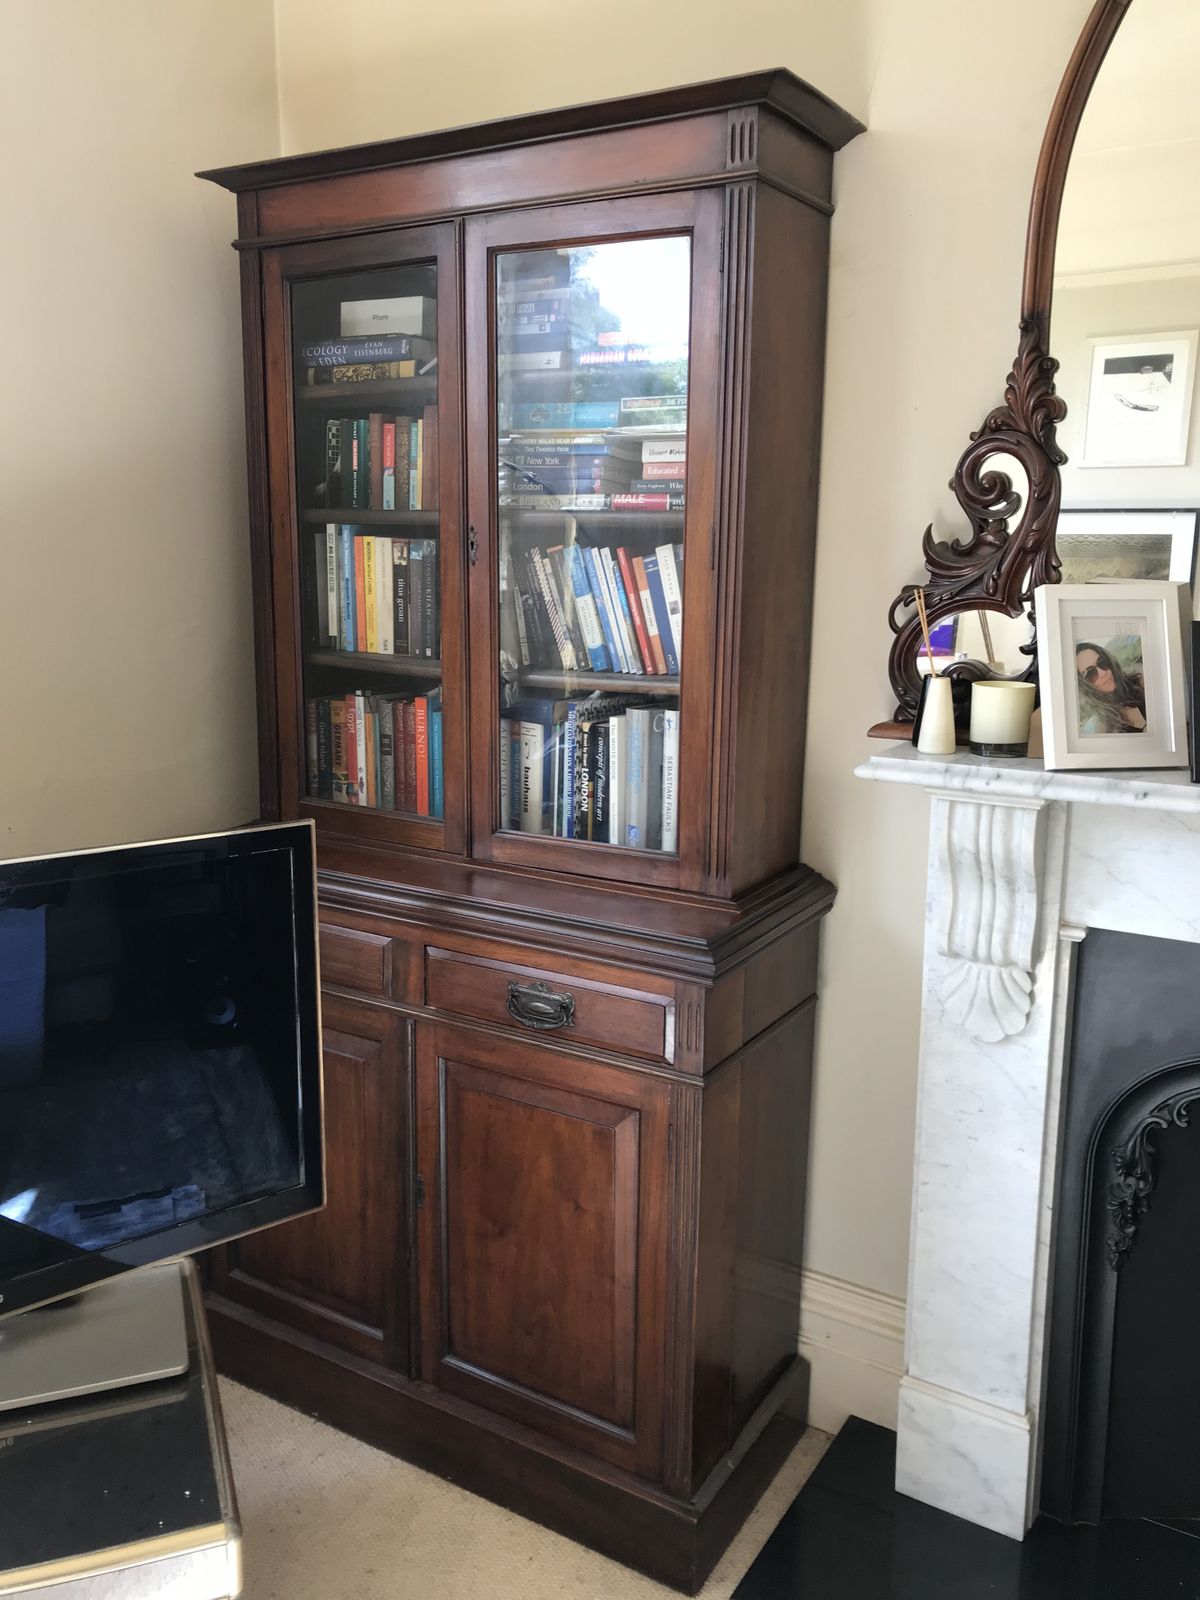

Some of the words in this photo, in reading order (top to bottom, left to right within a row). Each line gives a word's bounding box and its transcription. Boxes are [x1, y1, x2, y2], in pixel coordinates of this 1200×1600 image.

[527, 457, 543, 465] New
[544, 457, 560, 465] York
[647, 466, 678, 475] Educated
[513, 483, 543, 491] London
[614, 494, 646, 504] MALE
[397, 578, 406, 597] titus
[396, 597, 405, 623] groan
[346, 708, 356, 734] Egypt
[334, 725, 342, 767] GERMANY
[416, 709, 425, 767] BURNOU
[596, 737, 605, 768] concepts
[596, 769, 606, 780] of
[666, 755, 674, 801] SEBASTIAN
[523, 766, 531, 813] bauhaus
[581, 768, 589, 812] LONDON
[596, 779, 606, 808] modern
[596, 808, 604, 822] art
[665, 802, 673, 833] FAULKS
